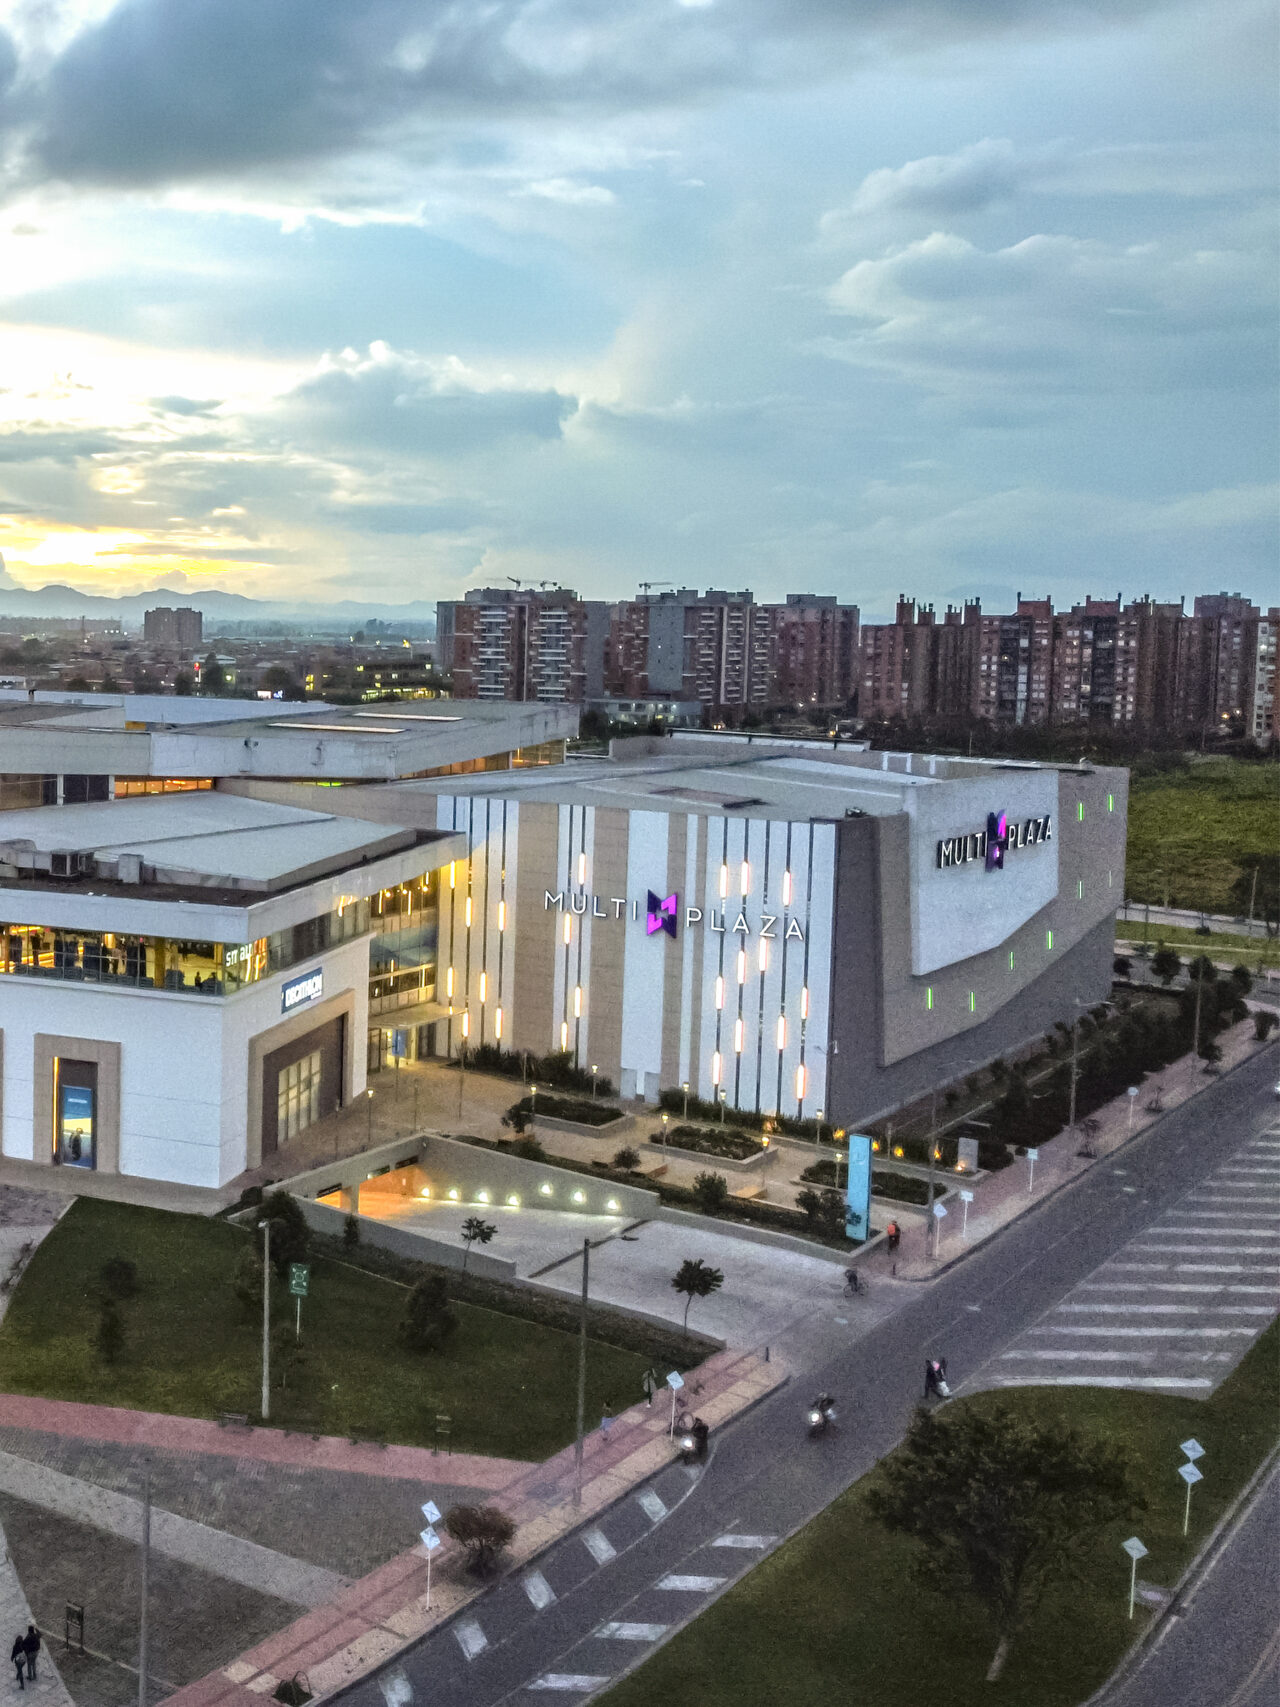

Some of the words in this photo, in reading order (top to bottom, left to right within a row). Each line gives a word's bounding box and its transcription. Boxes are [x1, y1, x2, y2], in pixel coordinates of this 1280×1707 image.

[940, 831, 988, 869] MULTI
[1006, 816, 1052, 851] PLAZA
[543, 889, 639, 921] MULTI
[686, 907, 806, 941] PLAZA
